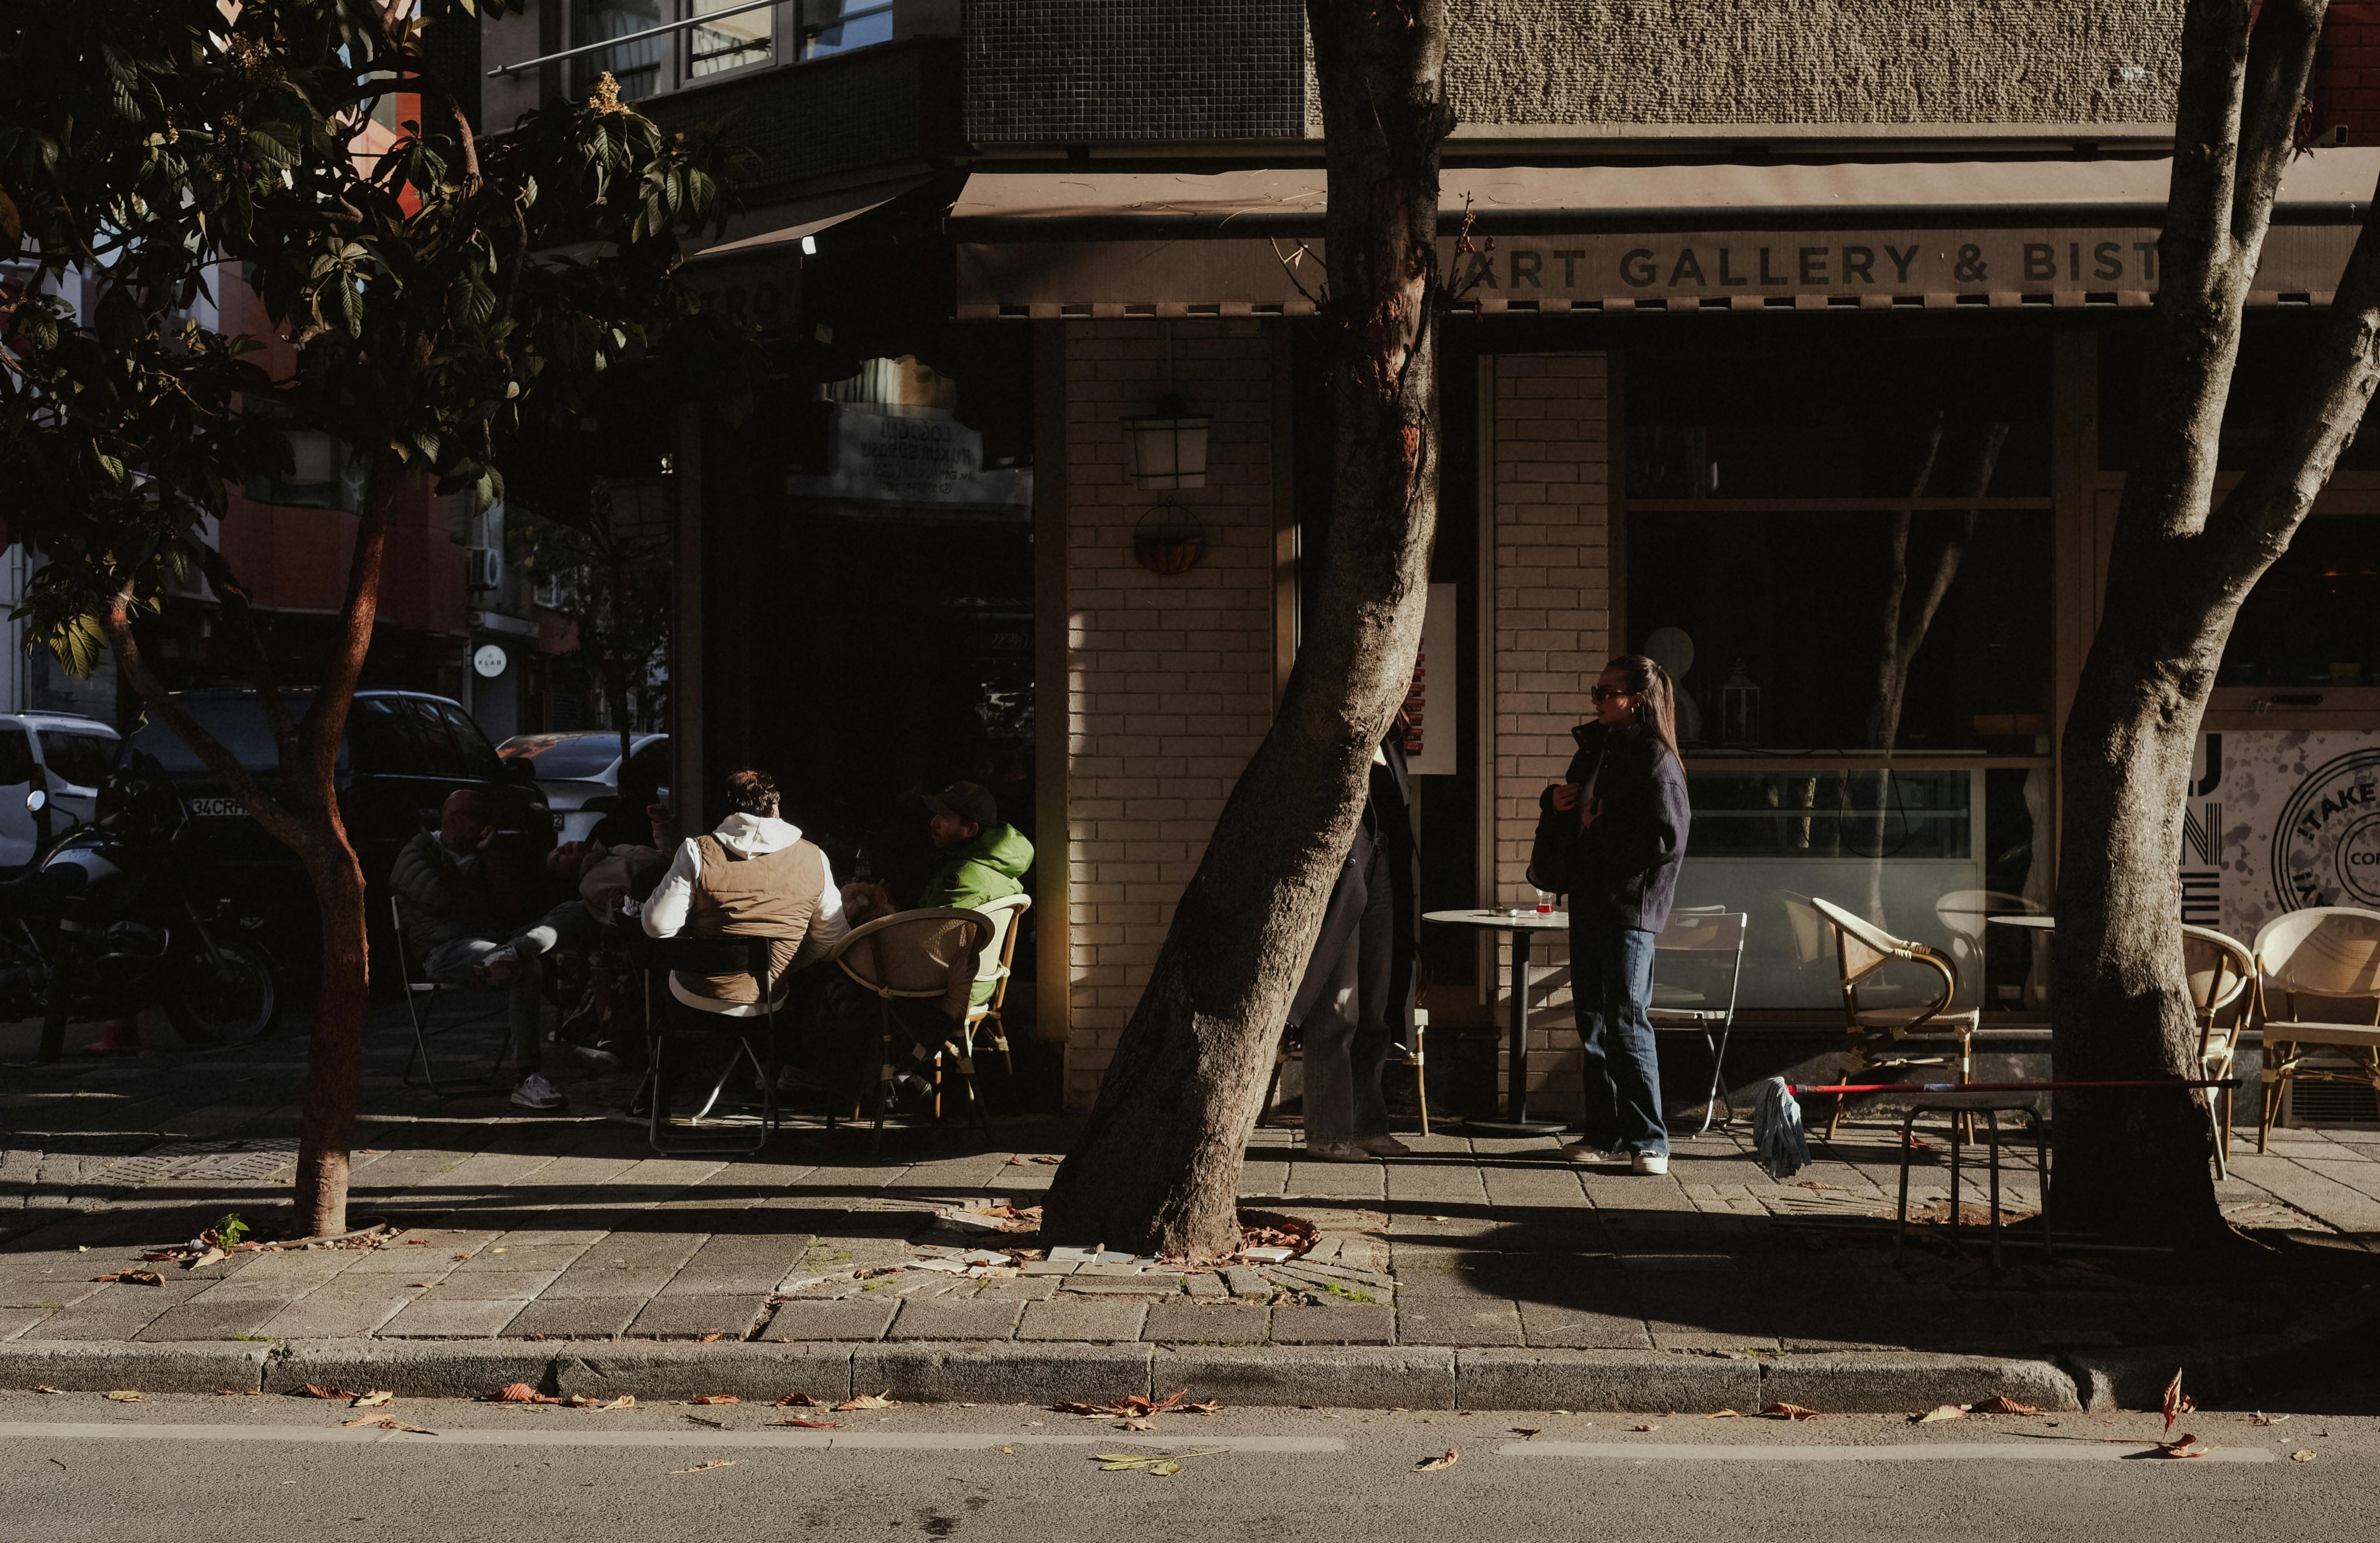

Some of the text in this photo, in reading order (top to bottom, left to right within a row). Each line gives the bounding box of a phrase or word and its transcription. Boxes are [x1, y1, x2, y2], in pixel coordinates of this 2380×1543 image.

[1460, 241, 2160, 289] ART GALLERY & BIST
